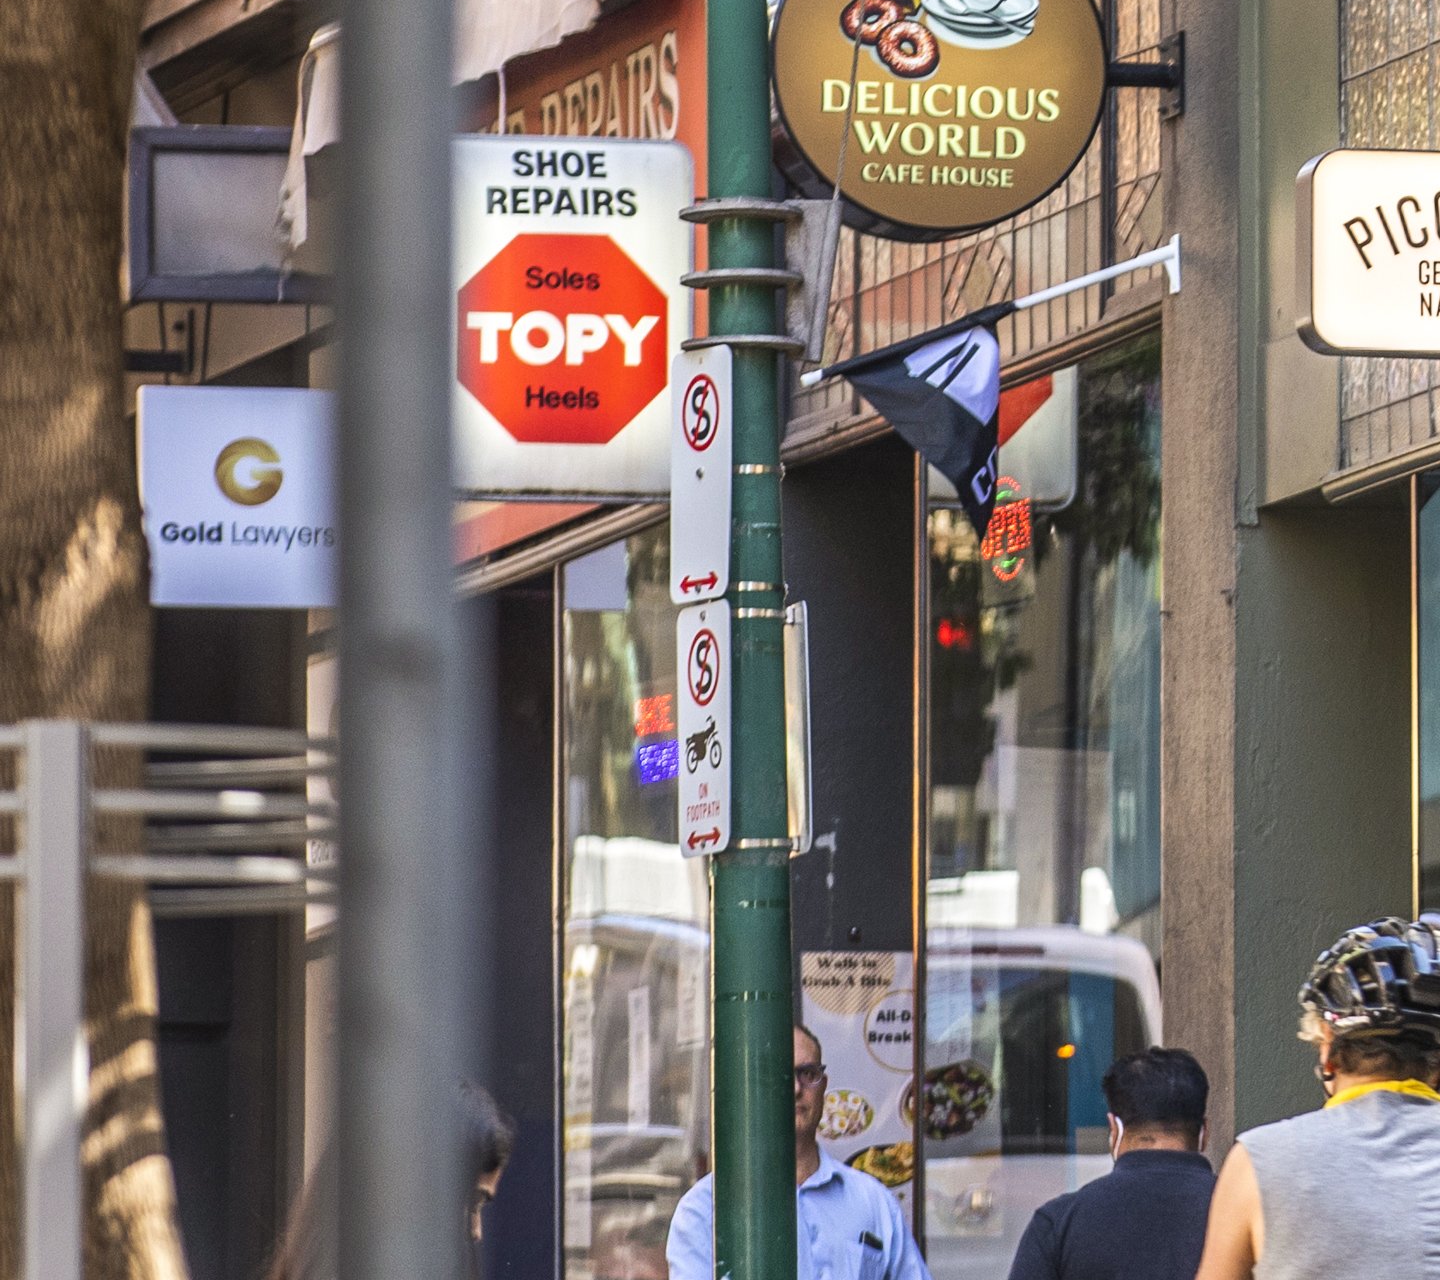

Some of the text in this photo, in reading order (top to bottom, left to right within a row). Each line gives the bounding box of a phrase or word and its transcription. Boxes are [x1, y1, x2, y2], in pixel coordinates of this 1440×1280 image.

[821, 79, 1060, 122] DELICIOUS
[853, 120, 1027, 160] WORLD
[513, 150, 607, 178] SHOE
[862, 162, 1014, 188] CAFE HOUSE
[487, 187, 638, 216] REPAIRS
[526, 266, 601, 290] Soles
[467, 310, 660, 366] TOPY
[525, 386, 599, 409] Heels
[161, 521, 336, 554] Gold Lawyers
[699, 783, 709, 800] ON
[686, 803, 721, 822] FOOTPATH
[876, 1010, 911, 1023] All-D
[868, 1030, 911, 1043] Break
